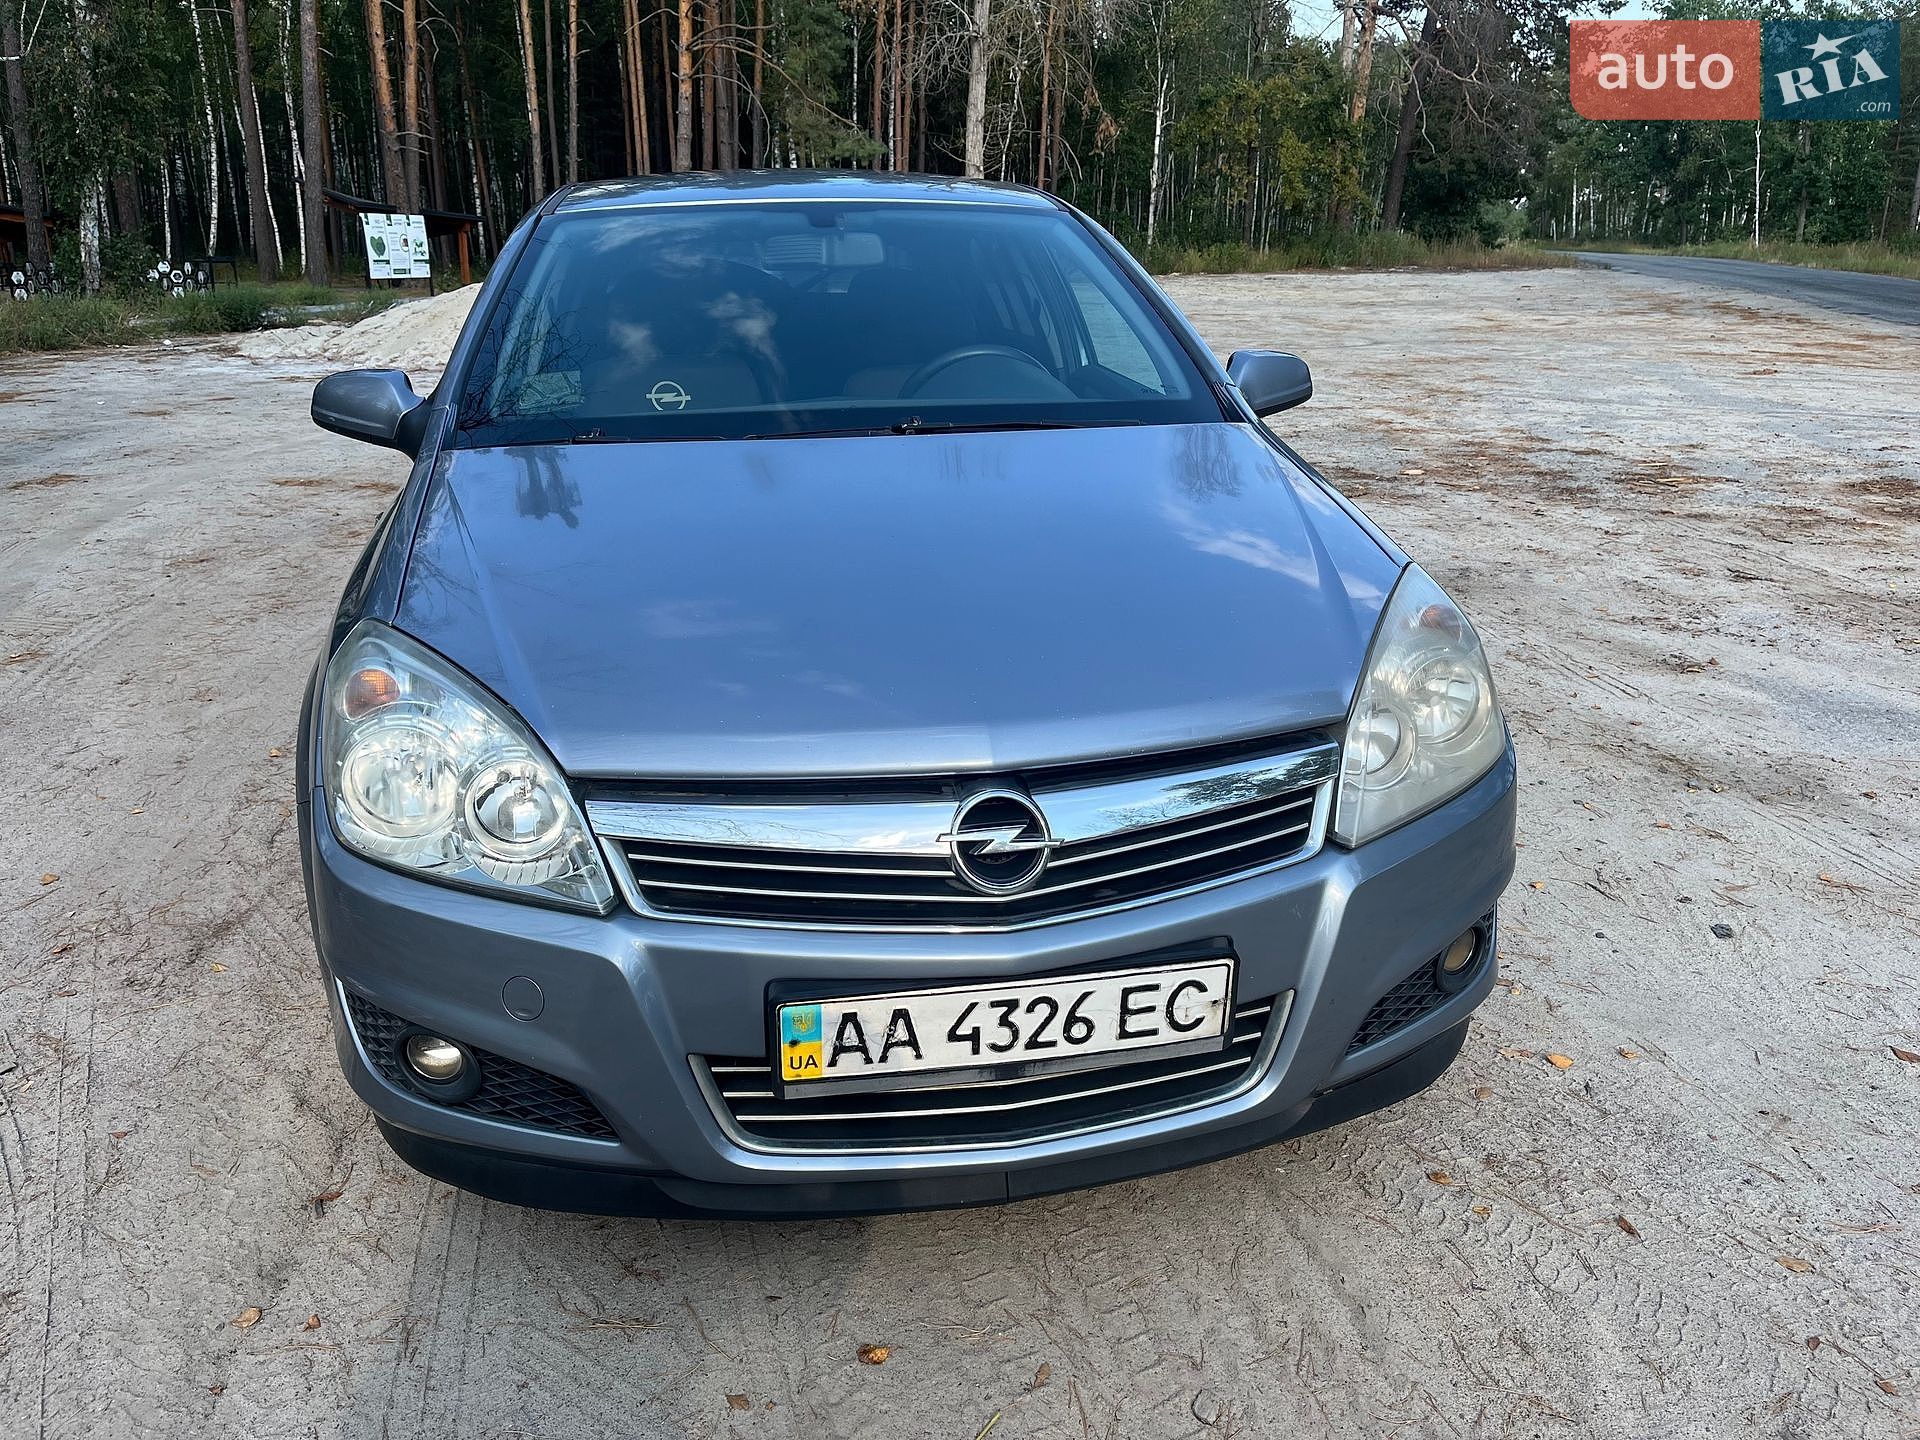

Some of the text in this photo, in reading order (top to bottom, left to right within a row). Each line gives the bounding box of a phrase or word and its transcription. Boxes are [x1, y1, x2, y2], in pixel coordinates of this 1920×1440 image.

[827, 979, 1208, 1068] AA 4326 EC
[789, 1055, 819, 1071] UA
